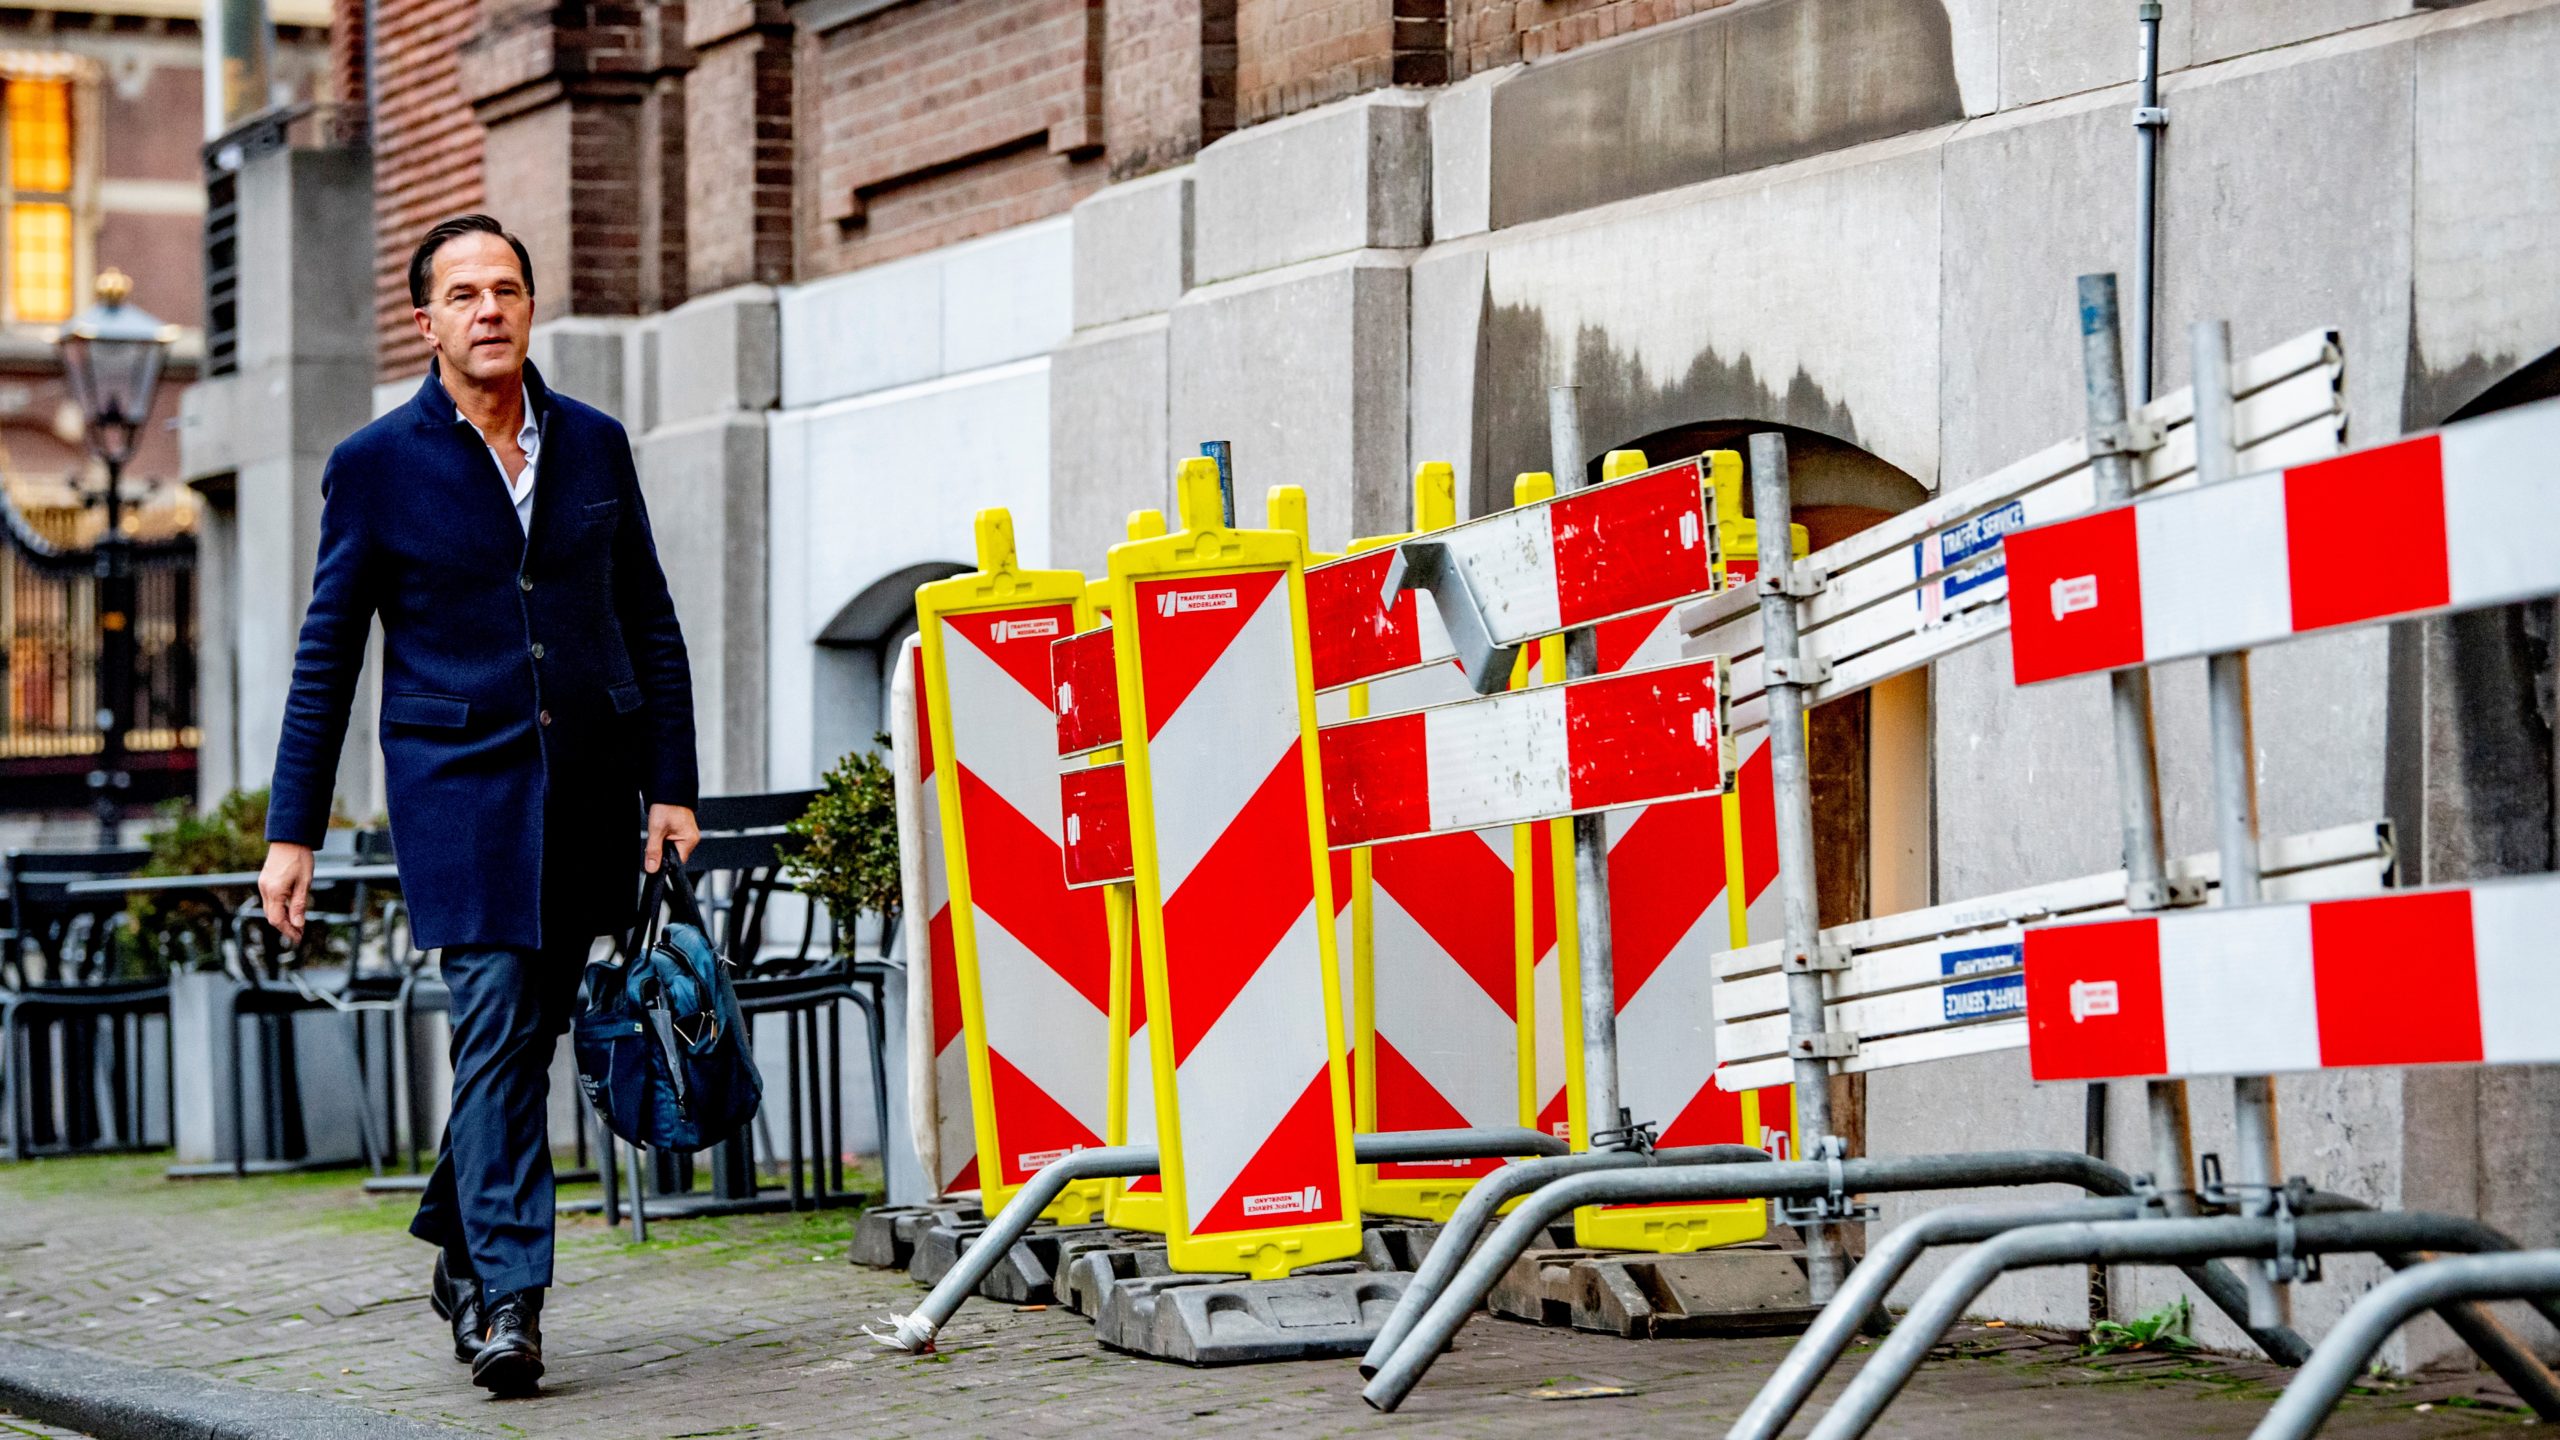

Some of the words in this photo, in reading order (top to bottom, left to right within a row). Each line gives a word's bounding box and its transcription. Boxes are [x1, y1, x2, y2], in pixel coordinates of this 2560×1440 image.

[1180, 594, 1206, 602] TRAFFIC
[1207, 592, 1233, 600] SERVICE
[1188, 600, 1226, 608] NEDERLAND
[1945, 990, 1987, 1017] SERVICE
[1254, 1195, 1292, 1204] NEDERLAND
[1247, 1204, 1273, 1212] SERVICE
[1275, 1202, 1300, 1210] TRAFFIC
